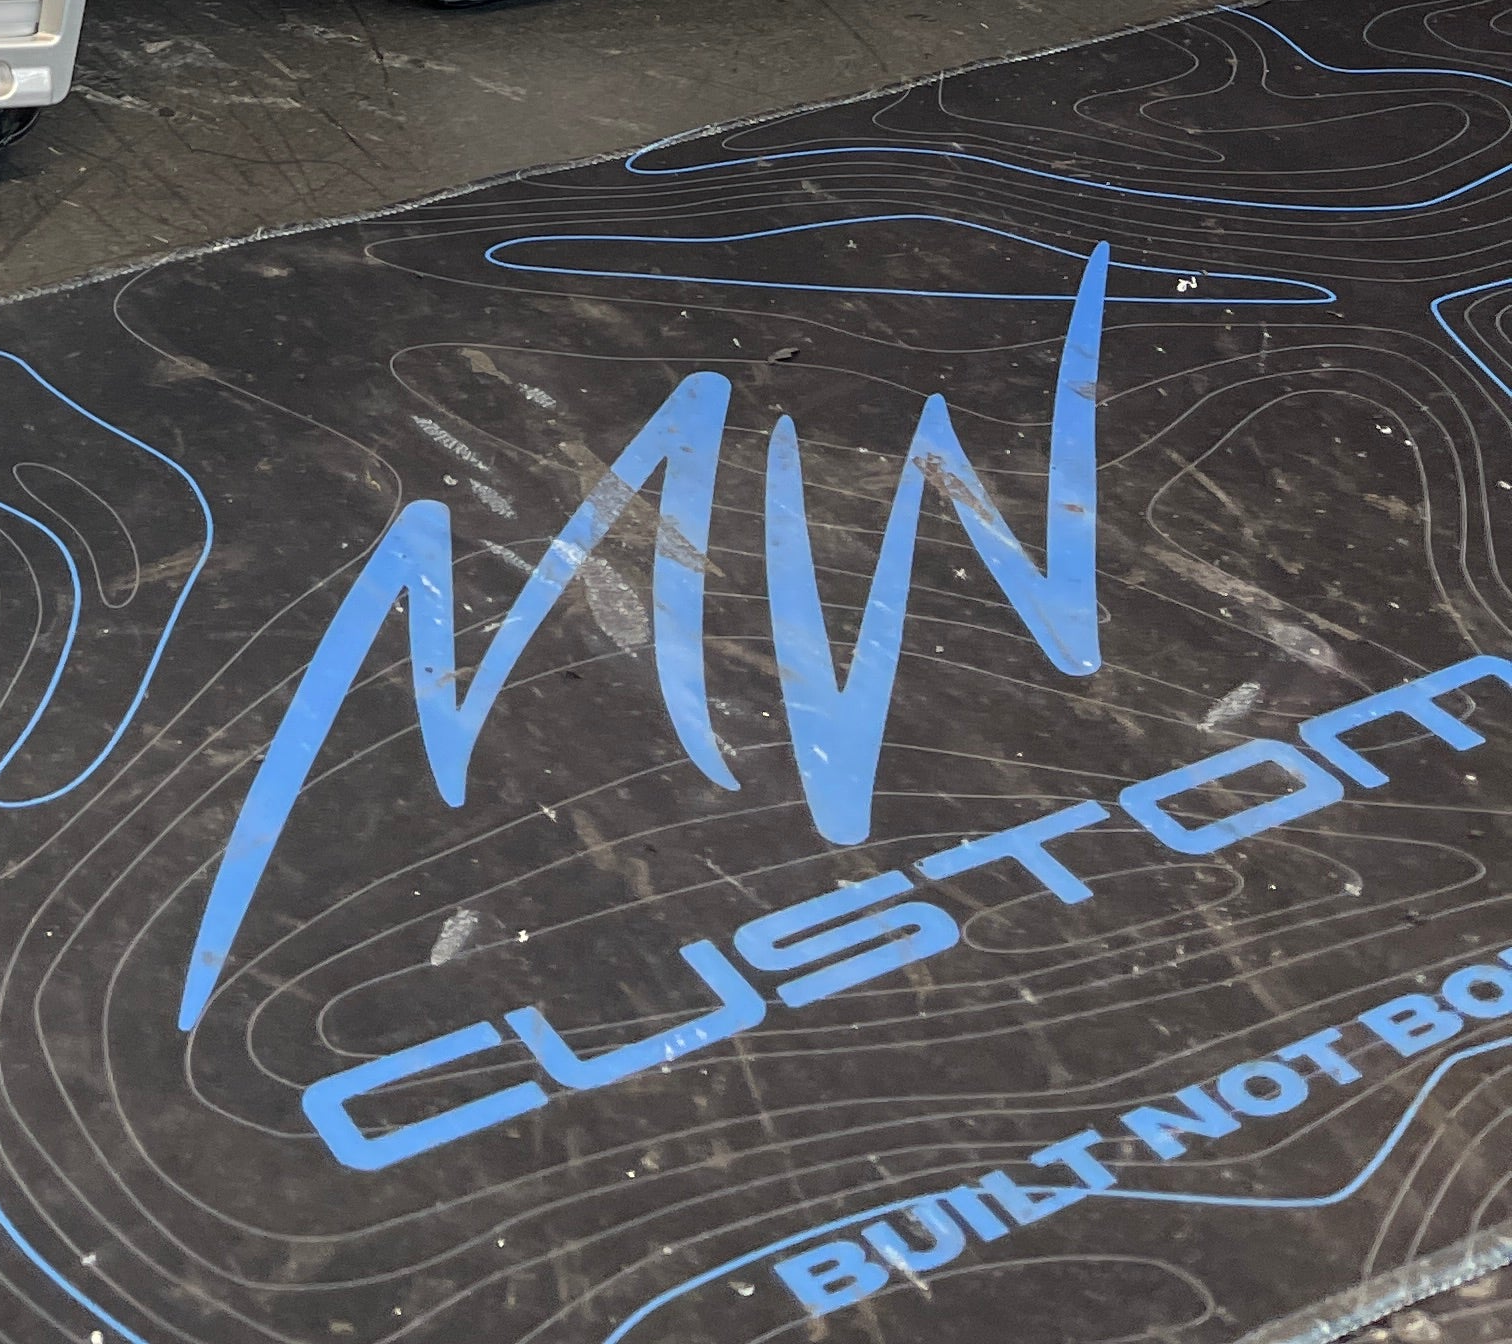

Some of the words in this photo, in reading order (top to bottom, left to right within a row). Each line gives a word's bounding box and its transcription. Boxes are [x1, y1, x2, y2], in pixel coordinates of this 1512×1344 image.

[772, 1127, 1119, 1318] BUILT
[1120, 1025, 1364, 1160] NOT
[1356, 942, 1512, 1059] BO
